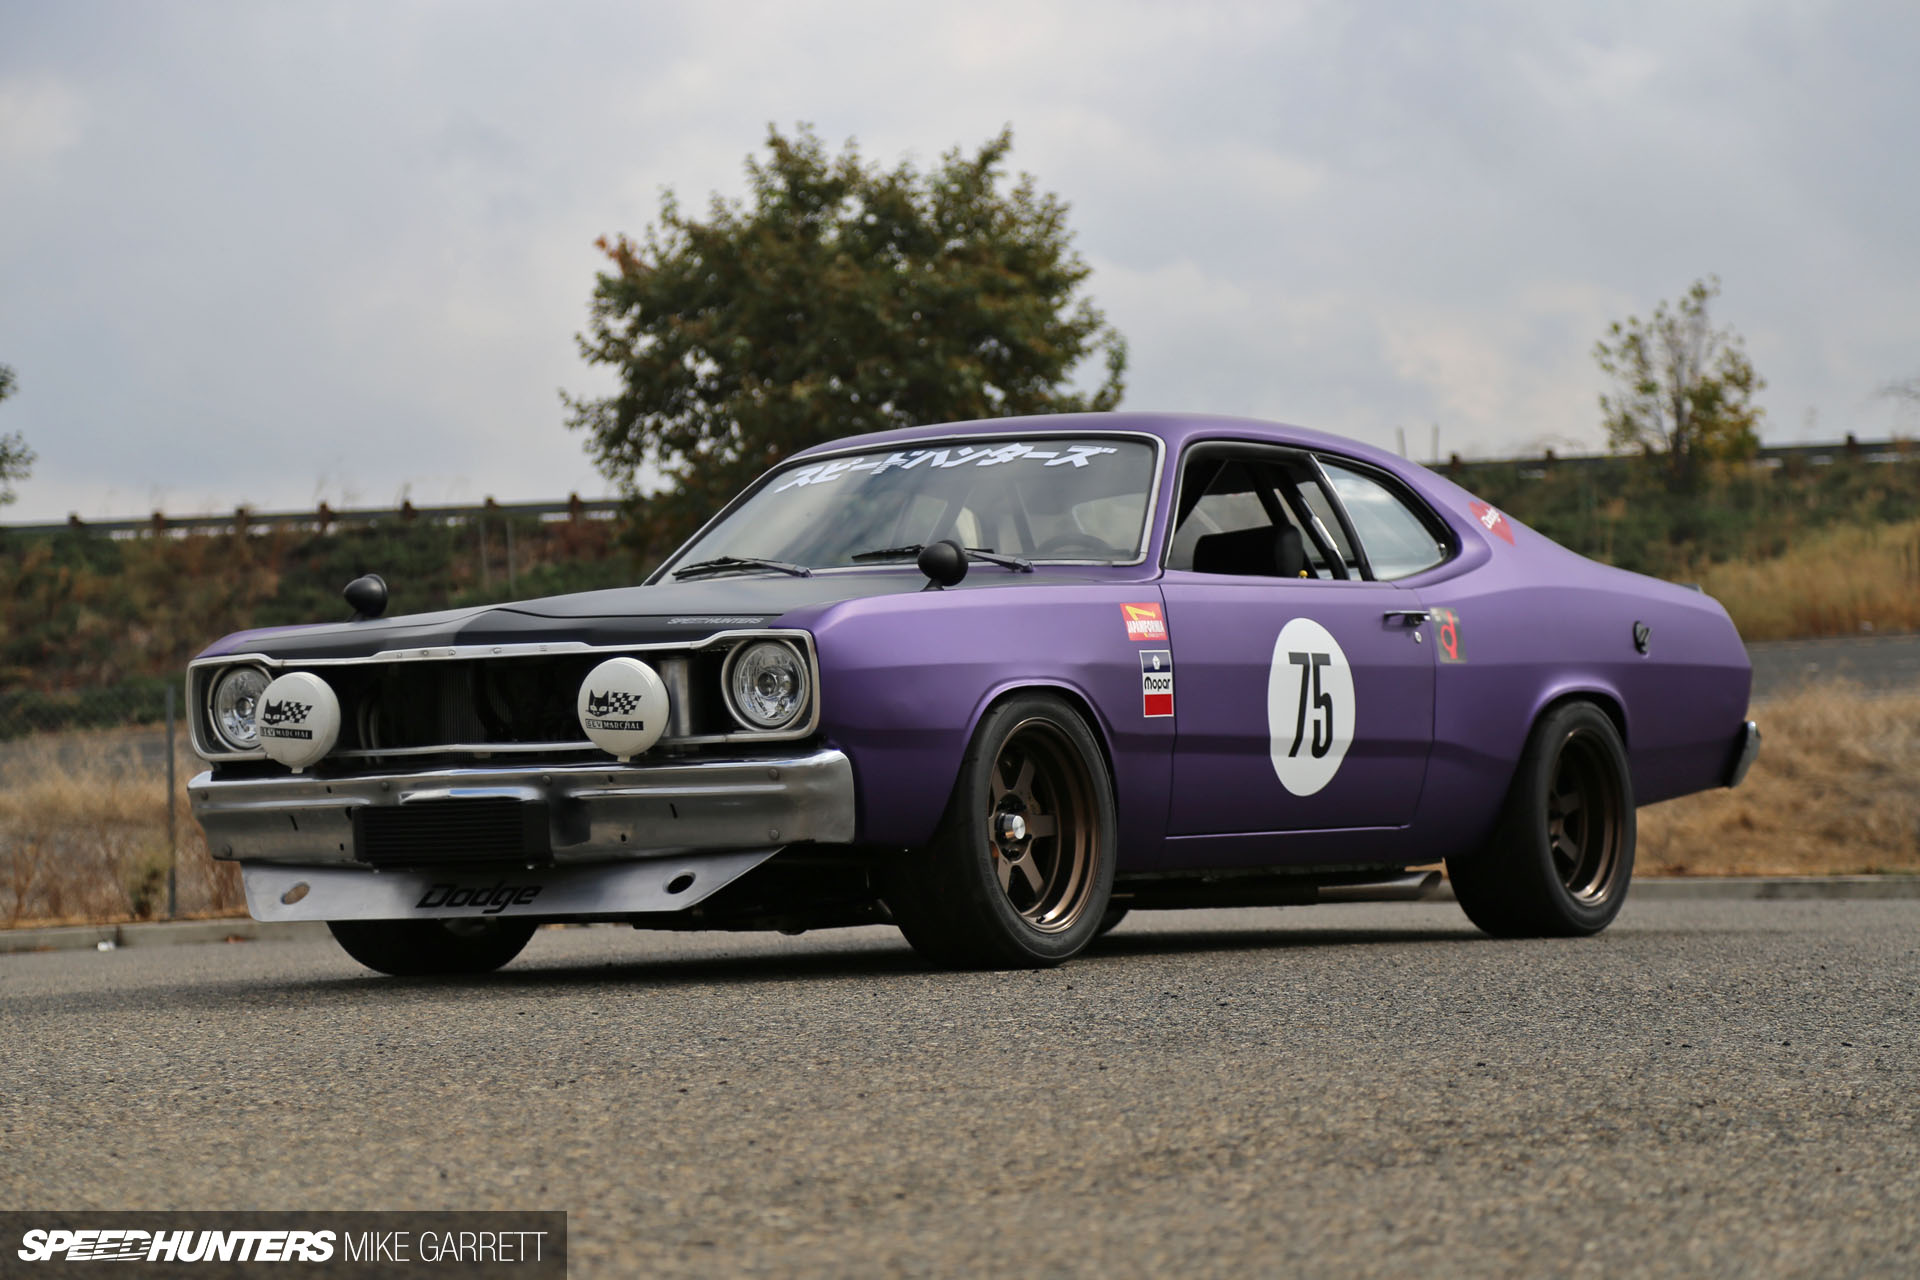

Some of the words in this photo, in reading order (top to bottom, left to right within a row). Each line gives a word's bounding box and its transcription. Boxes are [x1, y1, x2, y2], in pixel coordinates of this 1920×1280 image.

[774, 443, 1118, 494] スピードハンターズ
[1144, 676, 1171, 692] Mopar
[1288, 652, 1334, 759] 75
[603, 721, 640, 729] MARCHAL
[416, 880, 542, 914] Dodge
